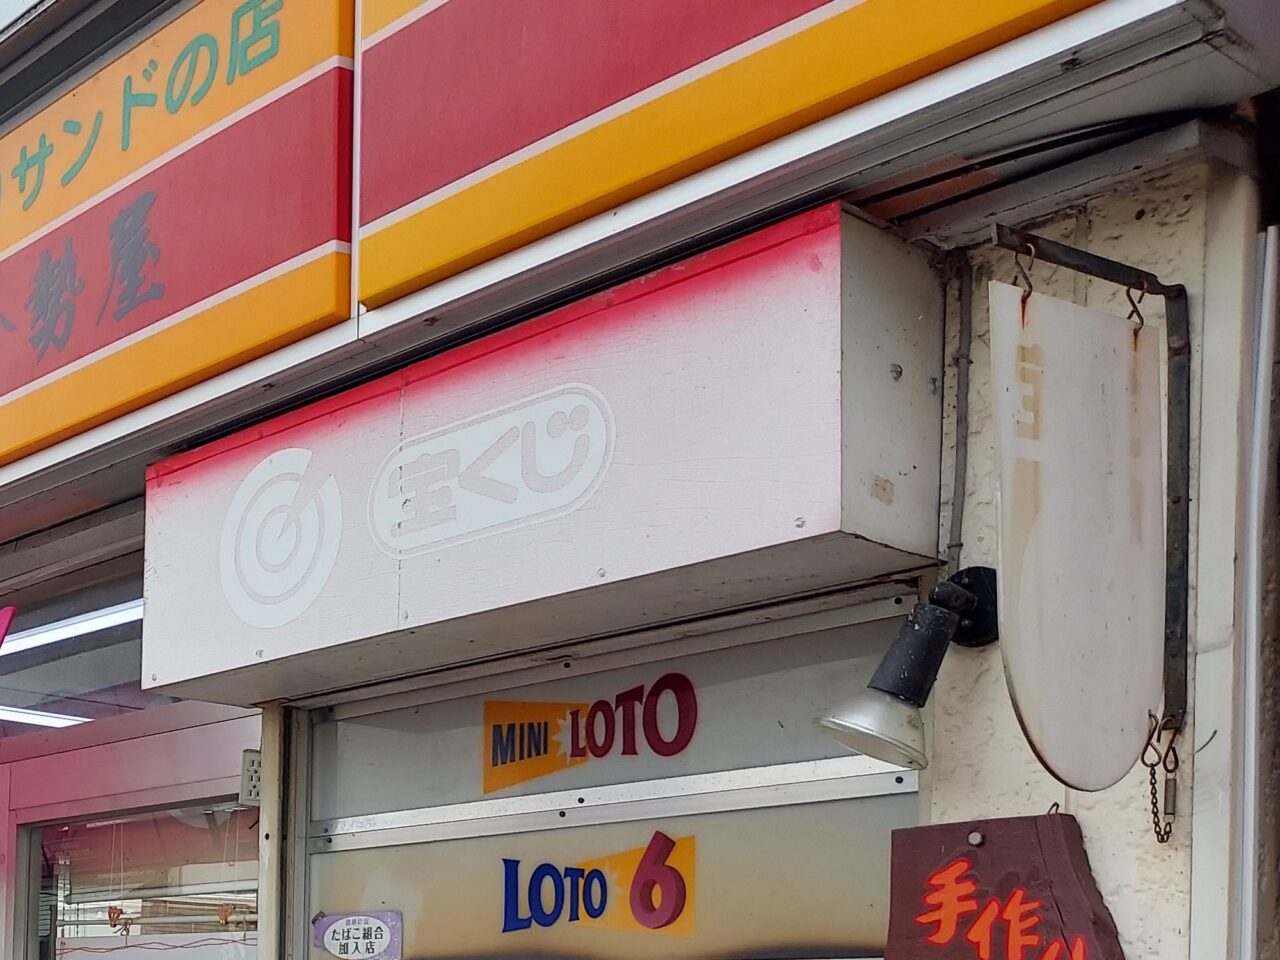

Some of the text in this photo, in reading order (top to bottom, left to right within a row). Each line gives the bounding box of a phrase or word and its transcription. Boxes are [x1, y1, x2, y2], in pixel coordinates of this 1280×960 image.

[387, 403, 591, 540] 宝くじ
[491, 672, 699, 768] MINI LOTO
[502, 829, 687, 933] LOTO 6
[331, 926, 384, 941] たばこ組合
[338, 941, 376, 955] 加入店
